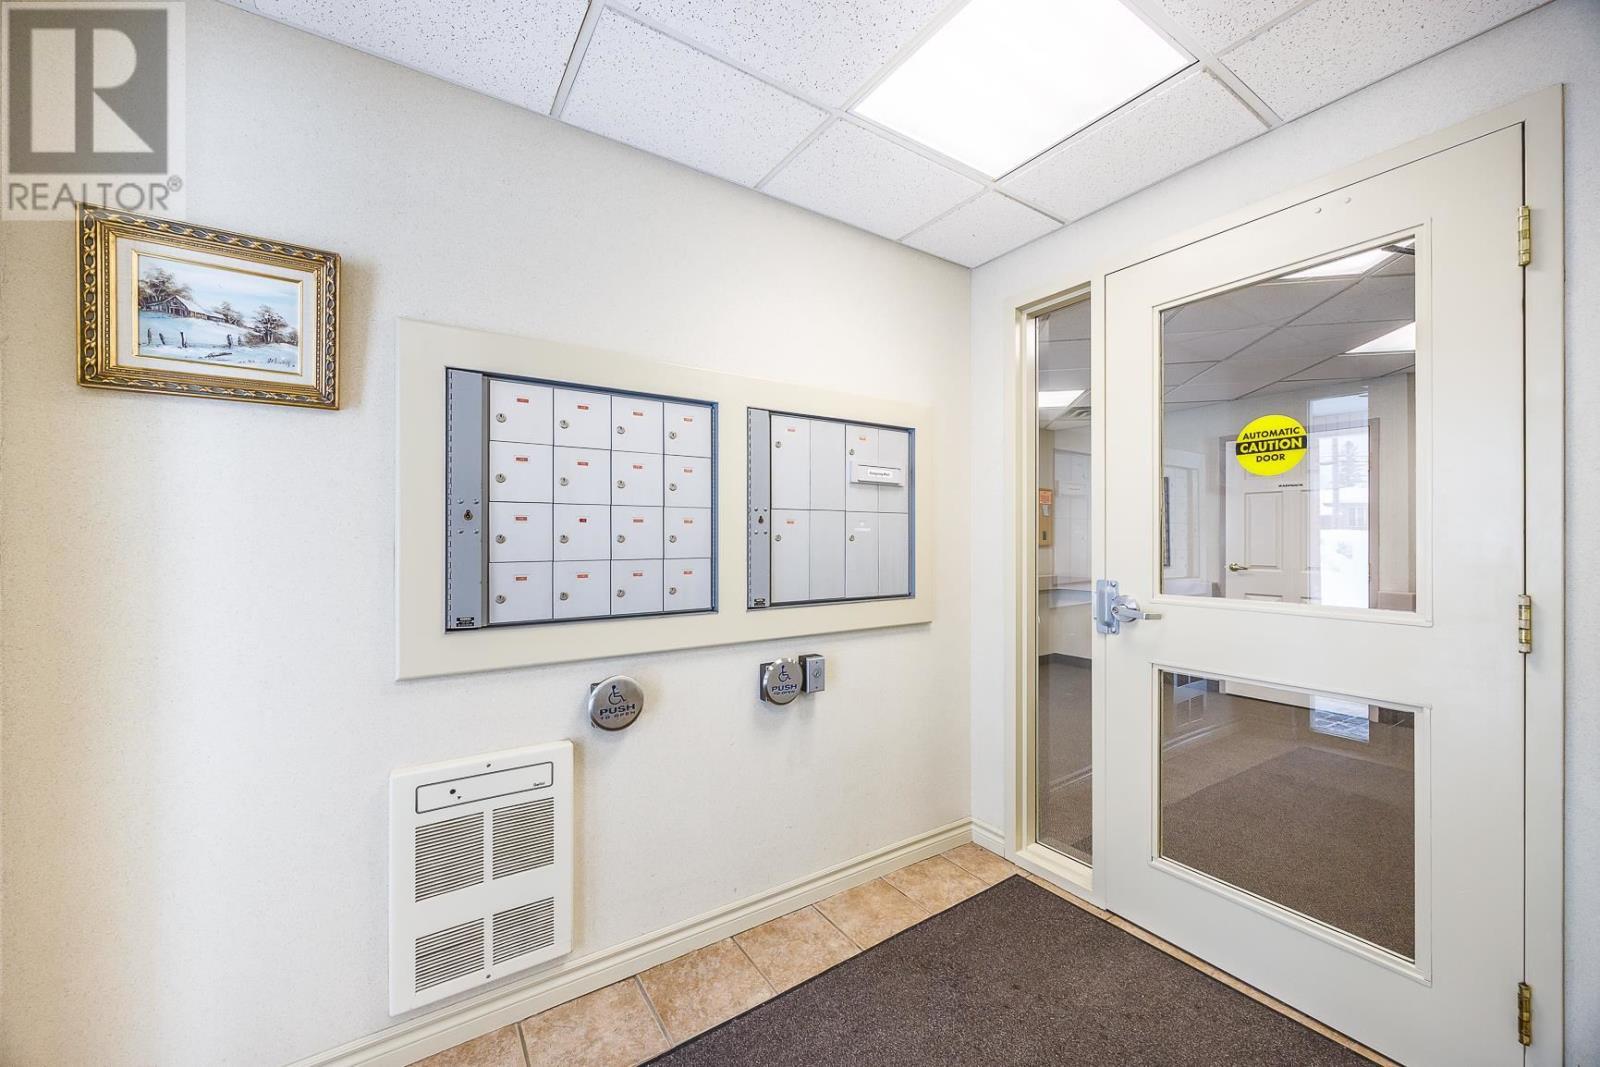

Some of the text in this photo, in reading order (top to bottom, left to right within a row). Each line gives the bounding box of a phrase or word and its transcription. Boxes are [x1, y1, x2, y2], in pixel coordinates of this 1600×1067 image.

[1243, 427, 1300, 440] AUTOMATIC
[1239, 438, 1303, 454] CAUTION
[1256, 453, 1285, 462] DOOR
[771, 684, 797, 692] PUSH
[600, 703, 635, 716] PUSH
